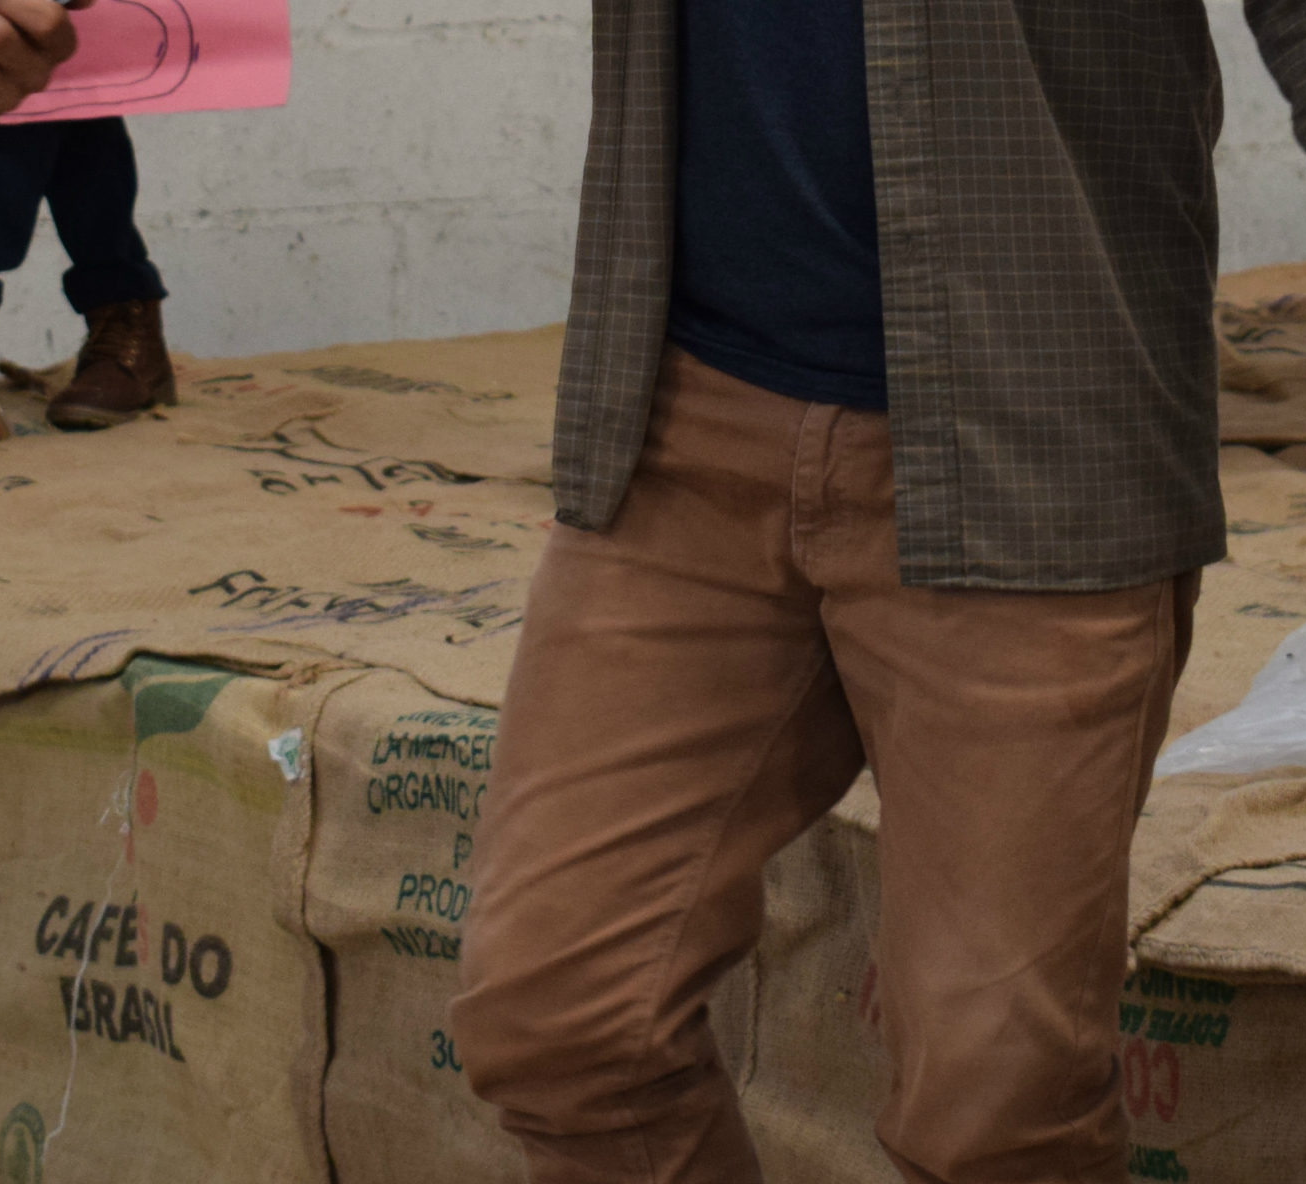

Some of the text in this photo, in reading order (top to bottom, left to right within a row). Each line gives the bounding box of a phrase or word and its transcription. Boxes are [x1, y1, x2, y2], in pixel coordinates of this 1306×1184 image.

[368, 771, 470, 820] ORGANIC
[397, 873, 472, 922] PROD
[161, 921, 232, 1000] DO
[59, 975, 186, 1064] BRASIL
